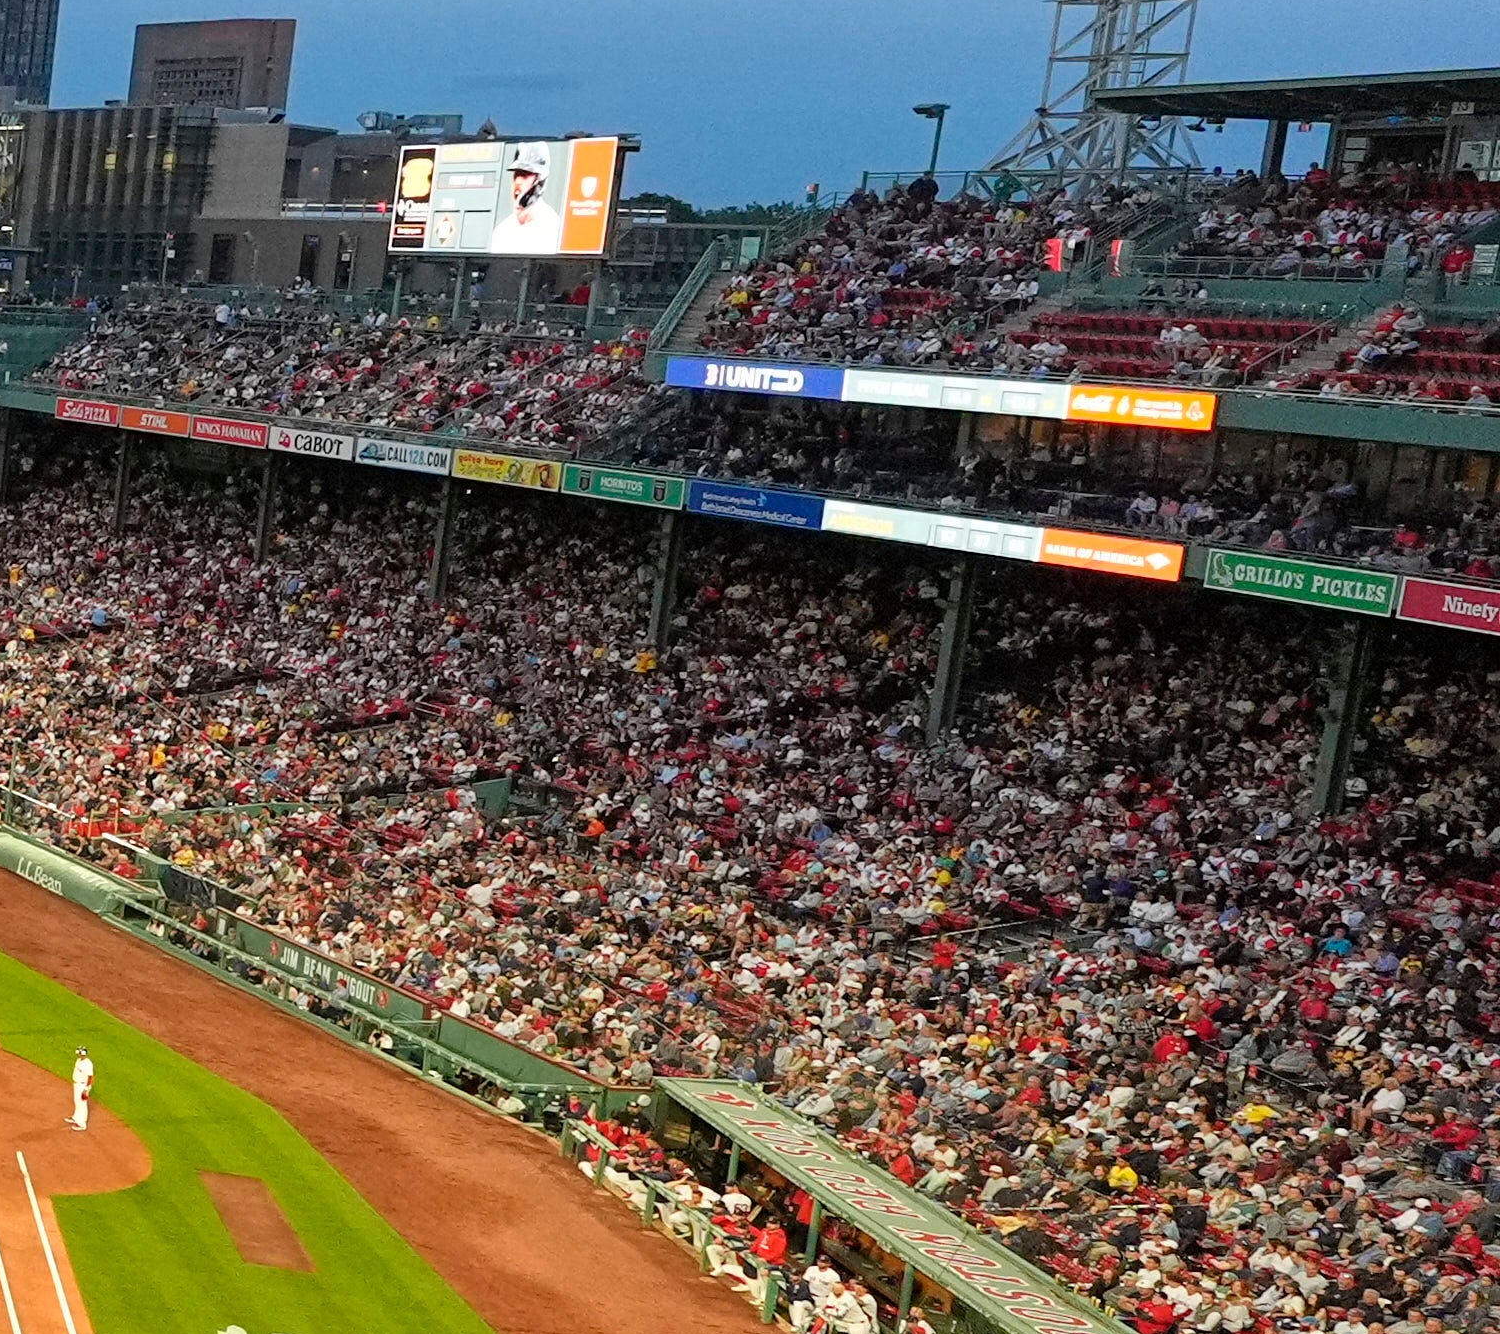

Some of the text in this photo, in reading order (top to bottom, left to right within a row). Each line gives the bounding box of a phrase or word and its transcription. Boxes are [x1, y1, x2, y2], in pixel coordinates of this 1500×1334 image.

[82, 406, 112, 424] PIZZA
[139, 412, 168, 428] STIHL
[387, 445, 449, 469] CALL128.COM
[600, 475, 644, 493] HORNITOS
[1233, 563, 1388, 604] GRILLO'S PICKLES
[1441, 594, 1500, 623] Ninety
[729, 1114, 838, 1166] SOX
[803, 1165, 928, 1222] RED
